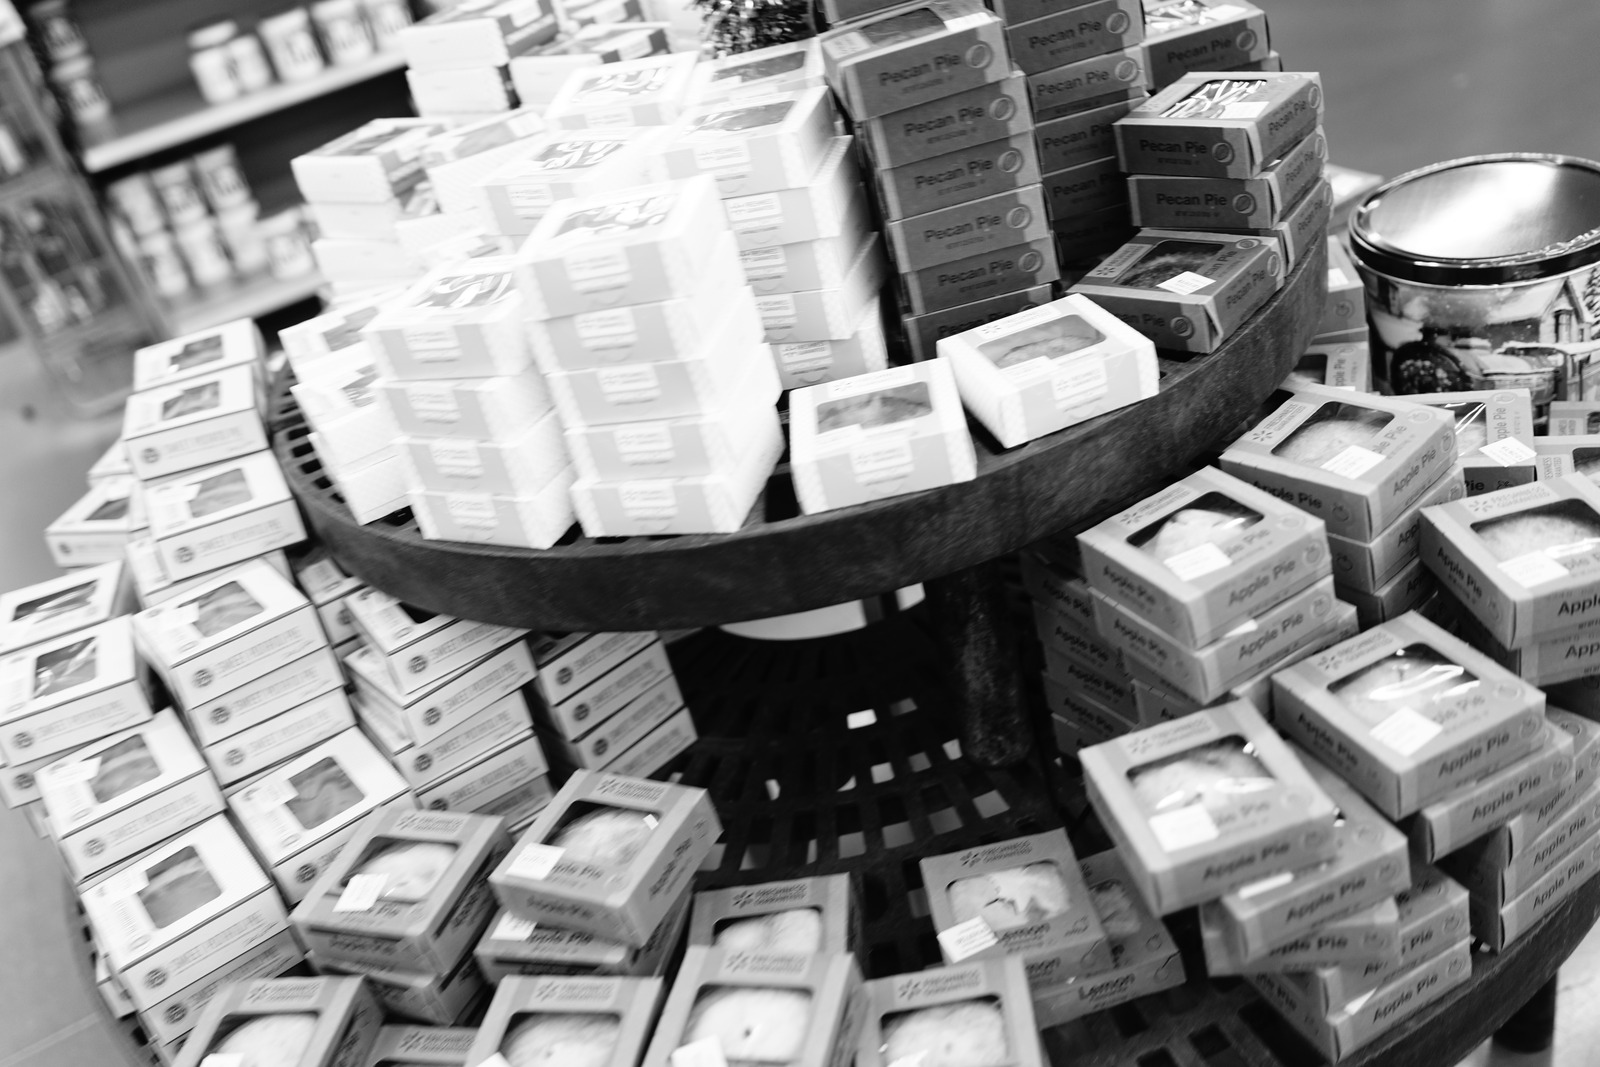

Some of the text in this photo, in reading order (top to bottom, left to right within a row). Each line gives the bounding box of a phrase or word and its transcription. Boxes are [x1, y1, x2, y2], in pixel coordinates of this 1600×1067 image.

[1028, 20, 1102, 49] Pecan Pie
[1167, 37, 1232, 63] Pecan Pie
[879, 53, 961, 86] Pecan Pie
[1036, 69, 1110, 97] Pecan Pie
[904, 106, 984, 136] Pecan Pie
[1042, 130, 1089, 150] Pecan
[1140, 139, 1207, 155] Pecan Pie
[914, 157, 994, 189] Pecan Pie
[1156, 193, 1227, 208] Pecan Pie
[924, 214, 1002, 242] Pecan Pie
[938, 258, 1014, 286] Pecan Pie
[1494, 421, 1511, 440] pple
[1393, 448, 1437, 496] Apple Pie
[1298, 492, 1323, 510] Pie
[1398, 518, 1420, 548] Appl
[1229, 559, 1296, 607] Apple Pie
[1437, 546, 1483, 599] Apple Pie
[1238, 613, 1304, 660] Apple Pie
[1564, 642, 1600, 659] App
[1438, 733, 1510, 779] Apple Pie
[1472, 775, 1542, 823] Apple Pie
[1537, 788, 1566, 823] Apple
[1533, 816, 1587, 867] Apple Pie
[1533, 859, 1586, 911] Apple Pie
[1410, 931, 1434, 950] Pie
[1372, 973, 1439, 1024] Apple Pie
